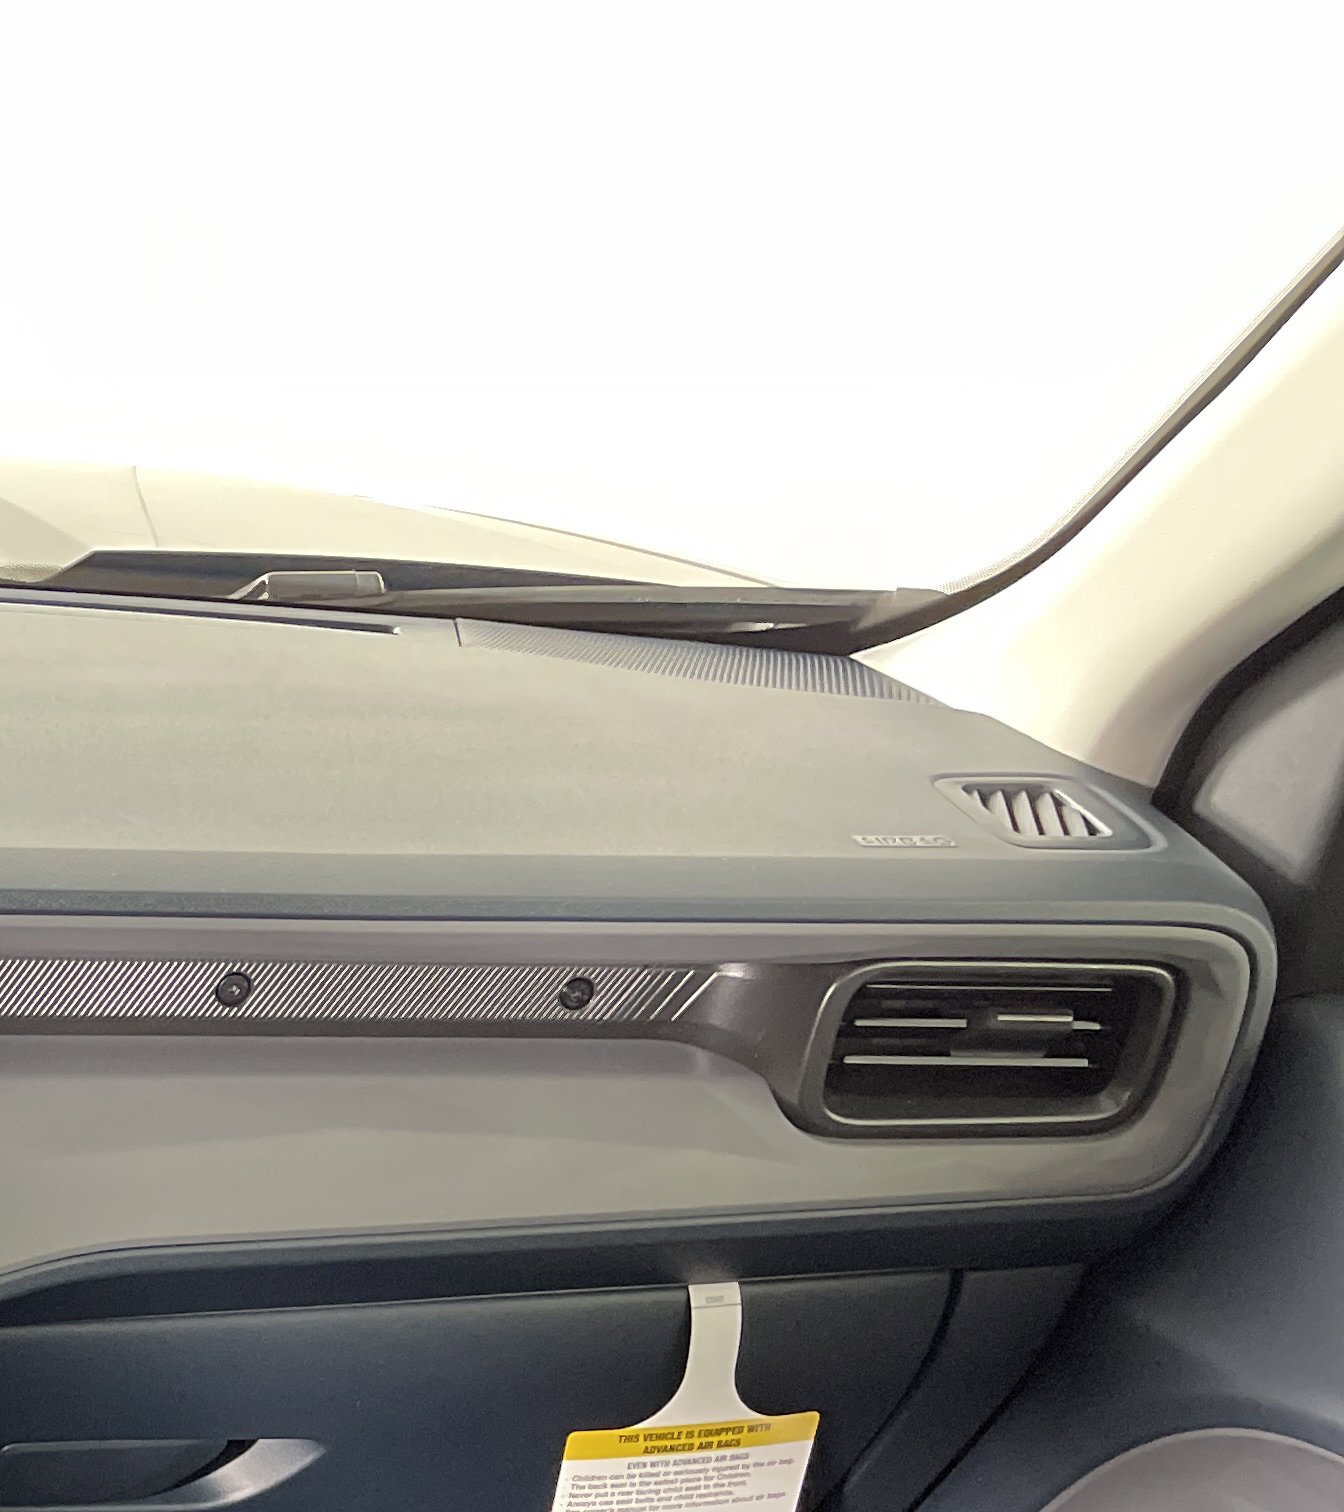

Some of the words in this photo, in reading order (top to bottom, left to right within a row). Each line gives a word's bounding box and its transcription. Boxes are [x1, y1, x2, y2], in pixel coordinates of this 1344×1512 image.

[618, 1434, 640, 1444] THIS
[643, 1431, 683, 1442] VEHICLE
[685, 1430, 695, 1439] IS
[698, 1426, 745, 1438] EQUIPPED
[746, 1423, 772, 1433] WITH
[643, 1443, 695, 1455] ADVANCED
[697, 1440, 715, 1450] AIR
[716, 1438, 741, 1448] BAGS
